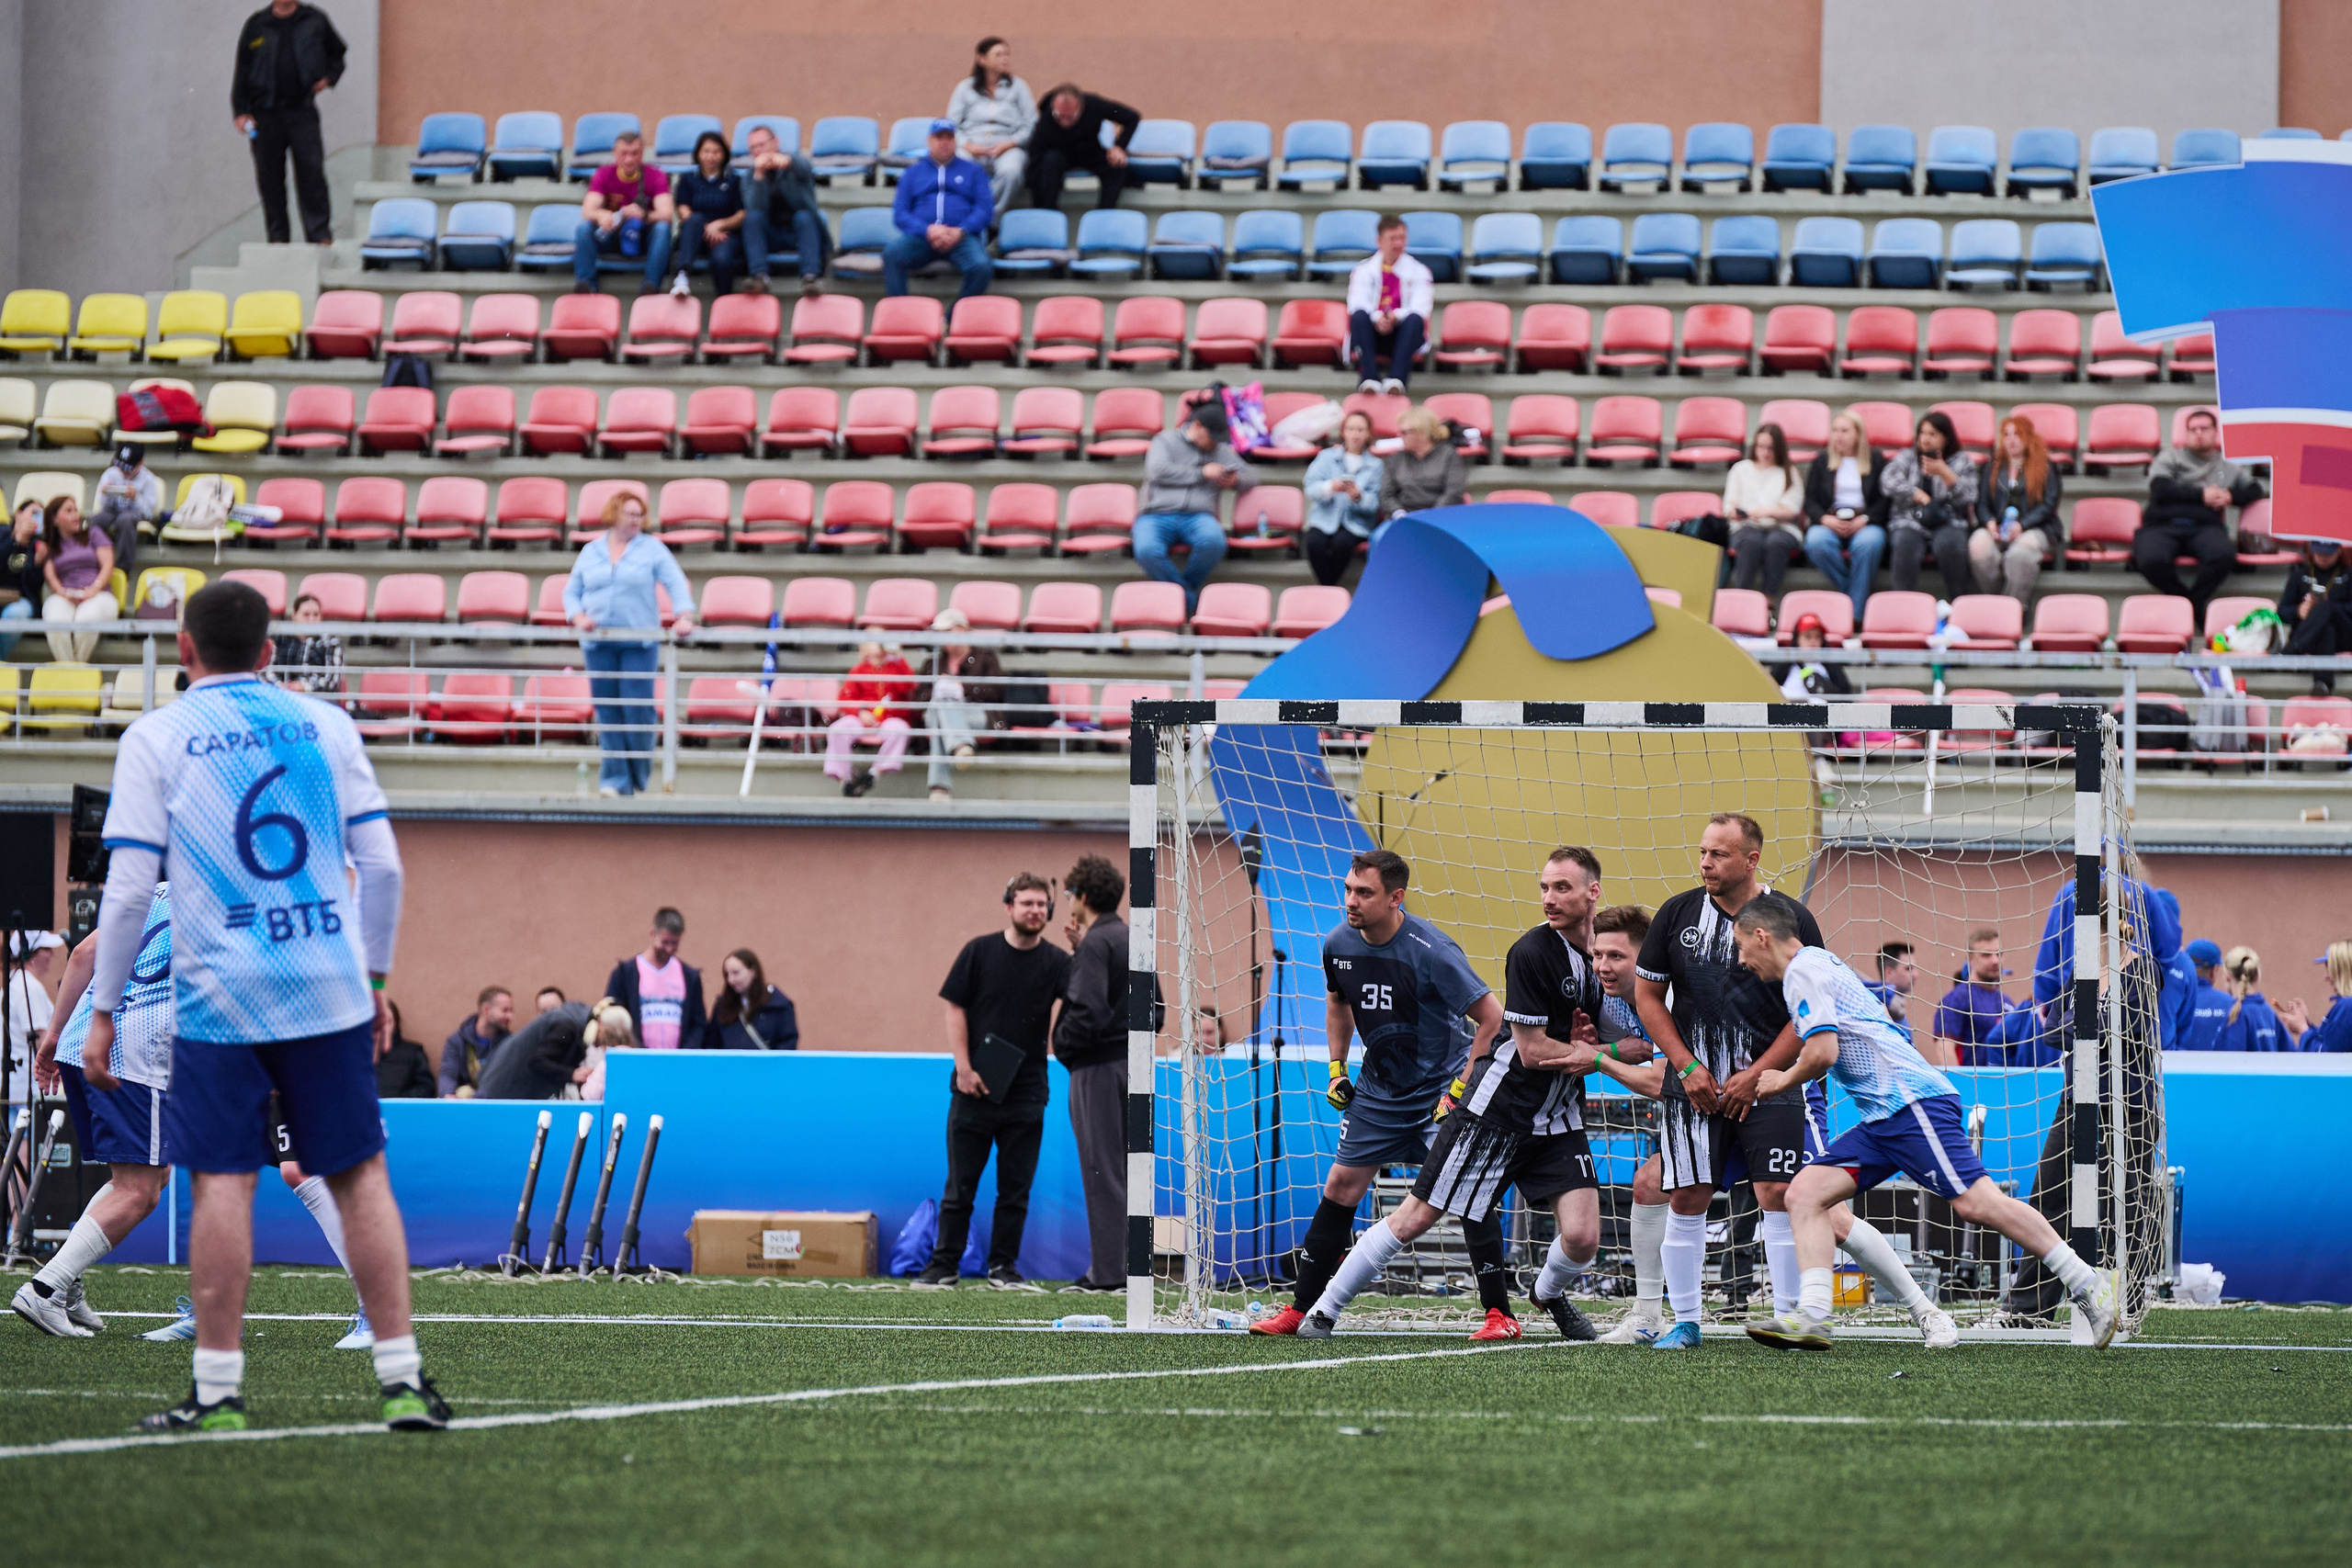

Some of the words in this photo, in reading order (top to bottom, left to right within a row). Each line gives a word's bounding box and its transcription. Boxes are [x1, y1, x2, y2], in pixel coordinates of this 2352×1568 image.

[187, 722, 319, 756] САРАТОВ
[235, 764, 308, 881] 6
[267, 899, 341, 942] ВТБ
[1339, 960, 1352, 970] ВТБ
[1361, 983, 1393, 1010] 35
[277, 1123, 290, 1153] 5
[1769, 1147, 1797, 1175] 22
